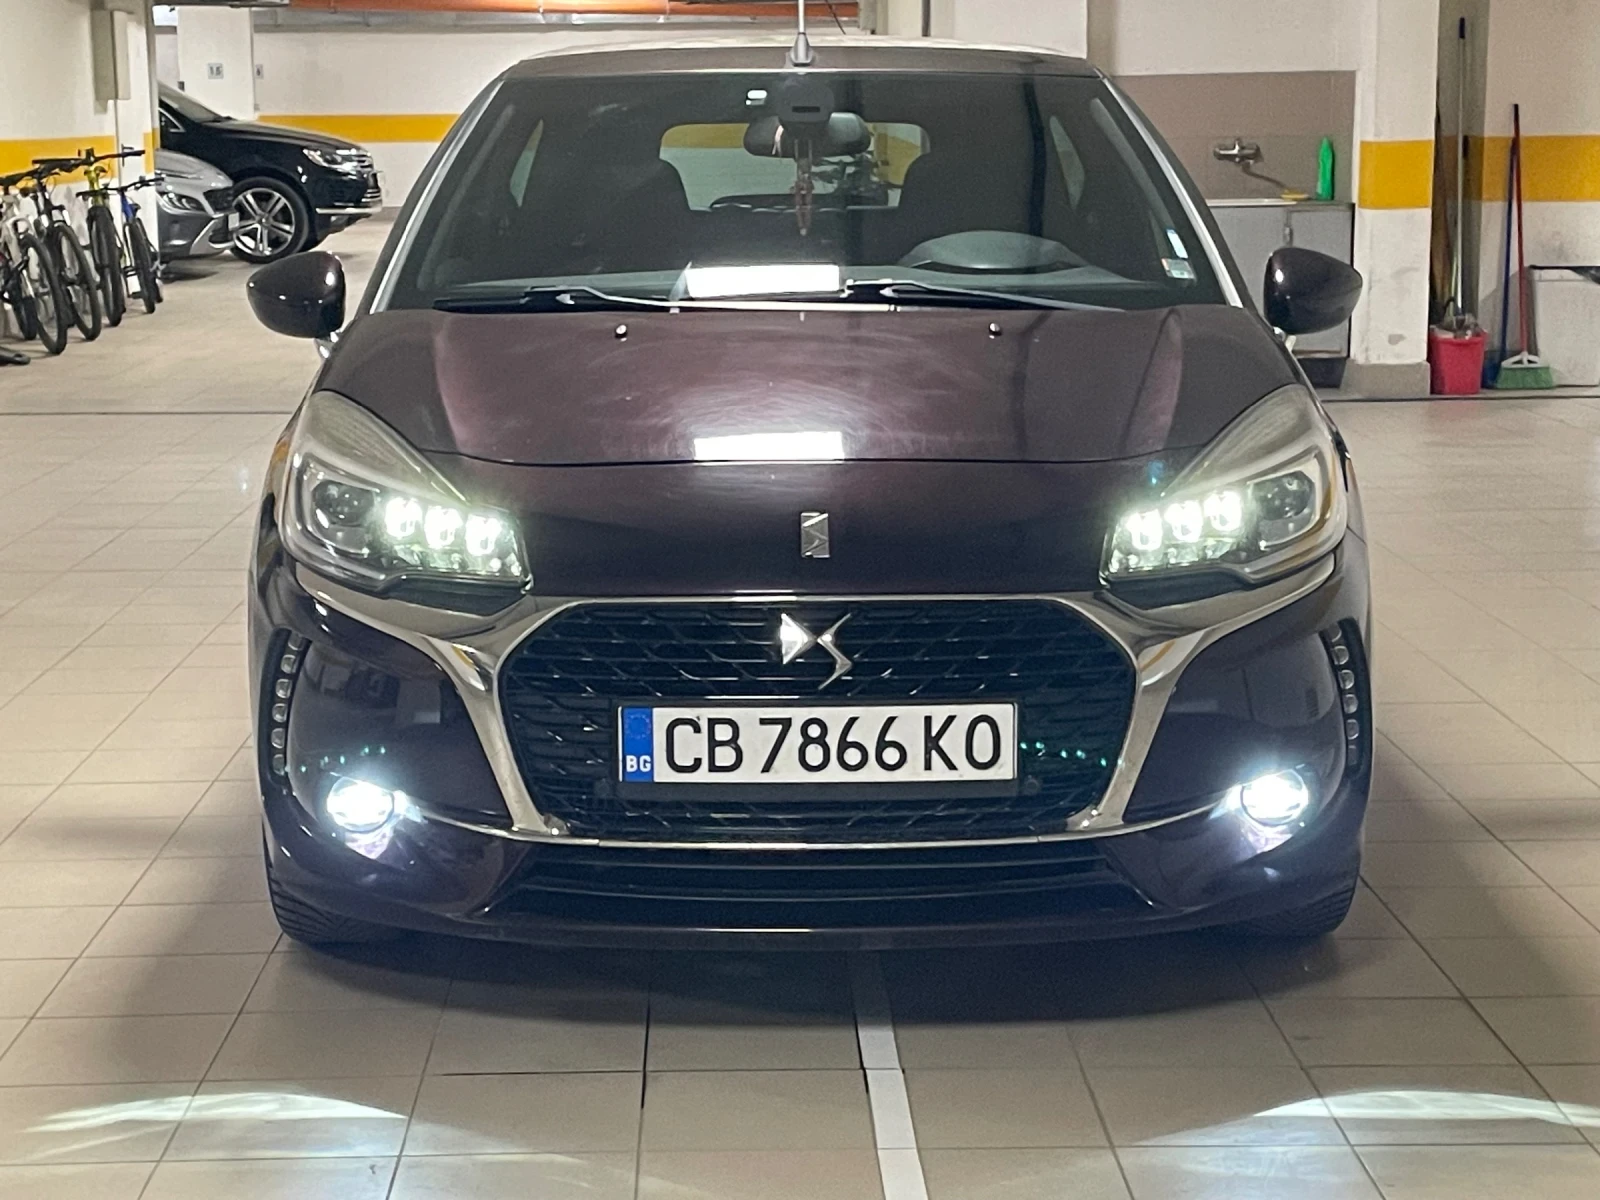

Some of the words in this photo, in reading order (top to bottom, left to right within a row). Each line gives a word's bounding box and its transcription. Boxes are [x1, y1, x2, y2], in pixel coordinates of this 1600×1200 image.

[665, 716, 743, 774] CB
[759, 715, 908, 774] 7866
[923, 713, 1002, 771] KO
[626, 755, 652, 773] BG
